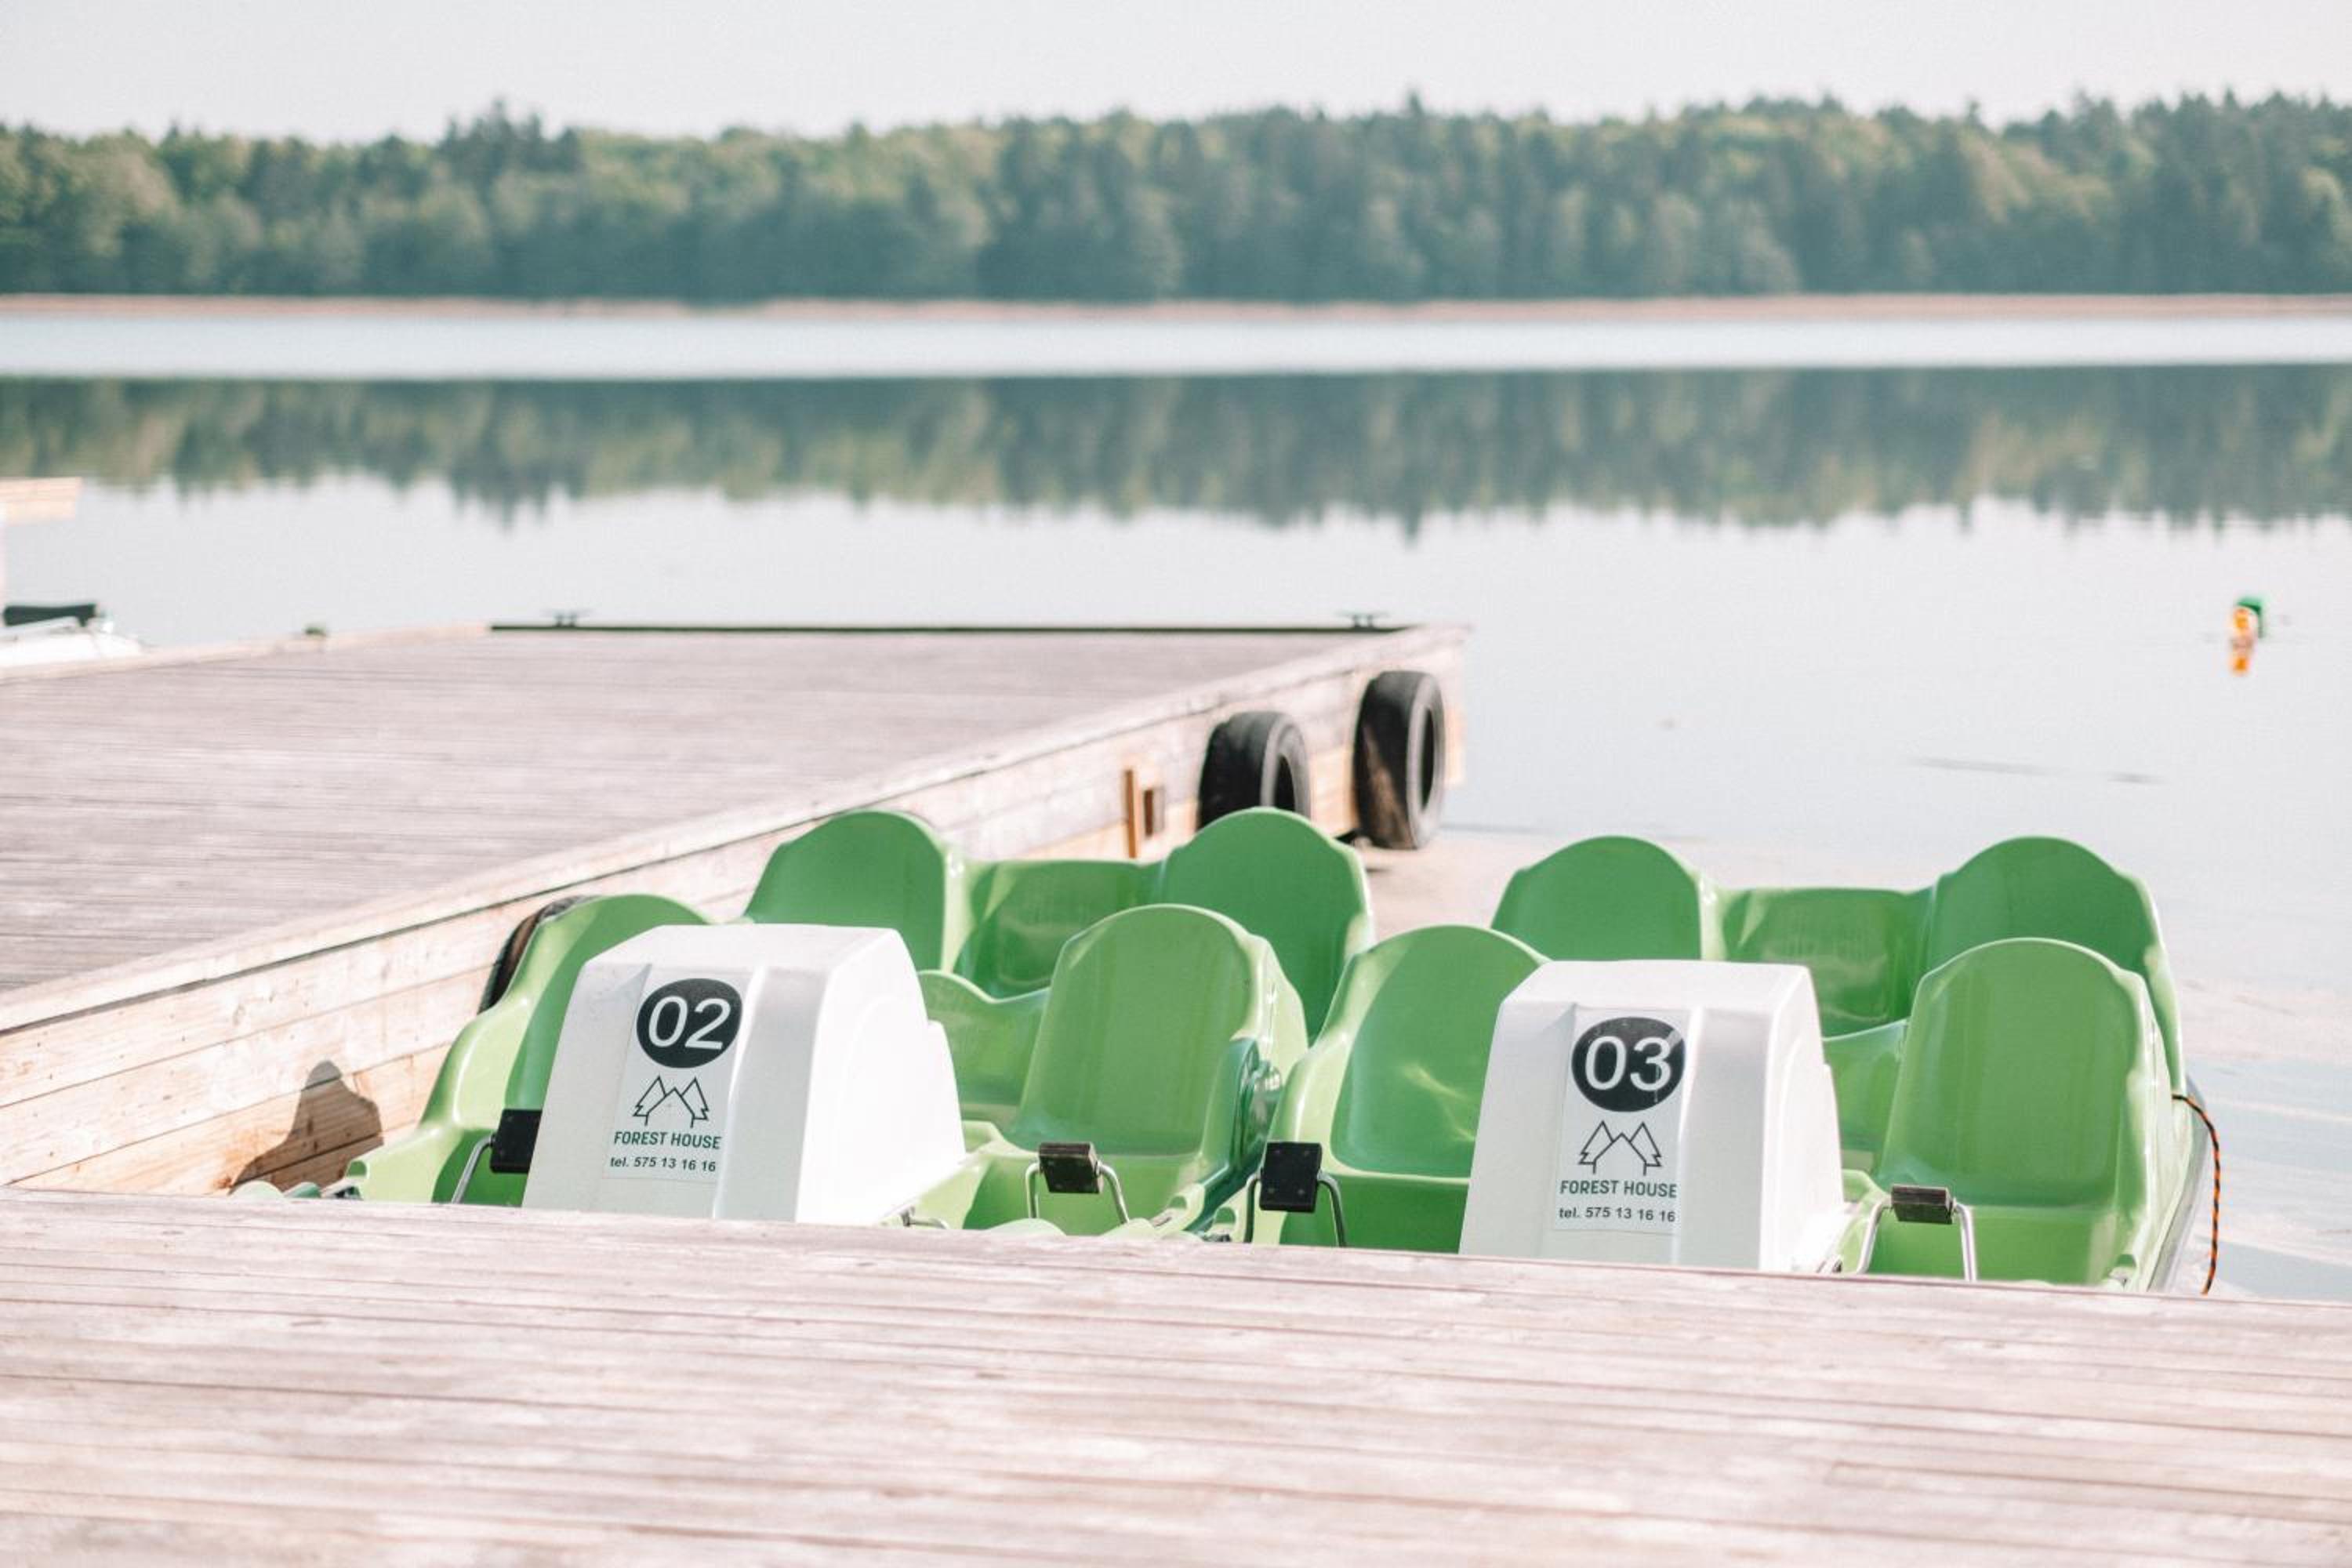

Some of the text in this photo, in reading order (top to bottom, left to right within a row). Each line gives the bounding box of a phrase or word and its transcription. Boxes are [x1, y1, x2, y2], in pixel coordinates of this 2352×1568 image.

[648, 996, 731, 1050] 02
[1584, 1036, 1671, 1091] 03
[614, 1131, 722, 1149] FOREST HOUSE
[610, 1156, 717, 1171] tel. 575 13 16 16
[1559, 1180, 1677, 1198] FOREST HOUSE
[1559, 1207, 1675, 1221] tel. 575 13 16 16
